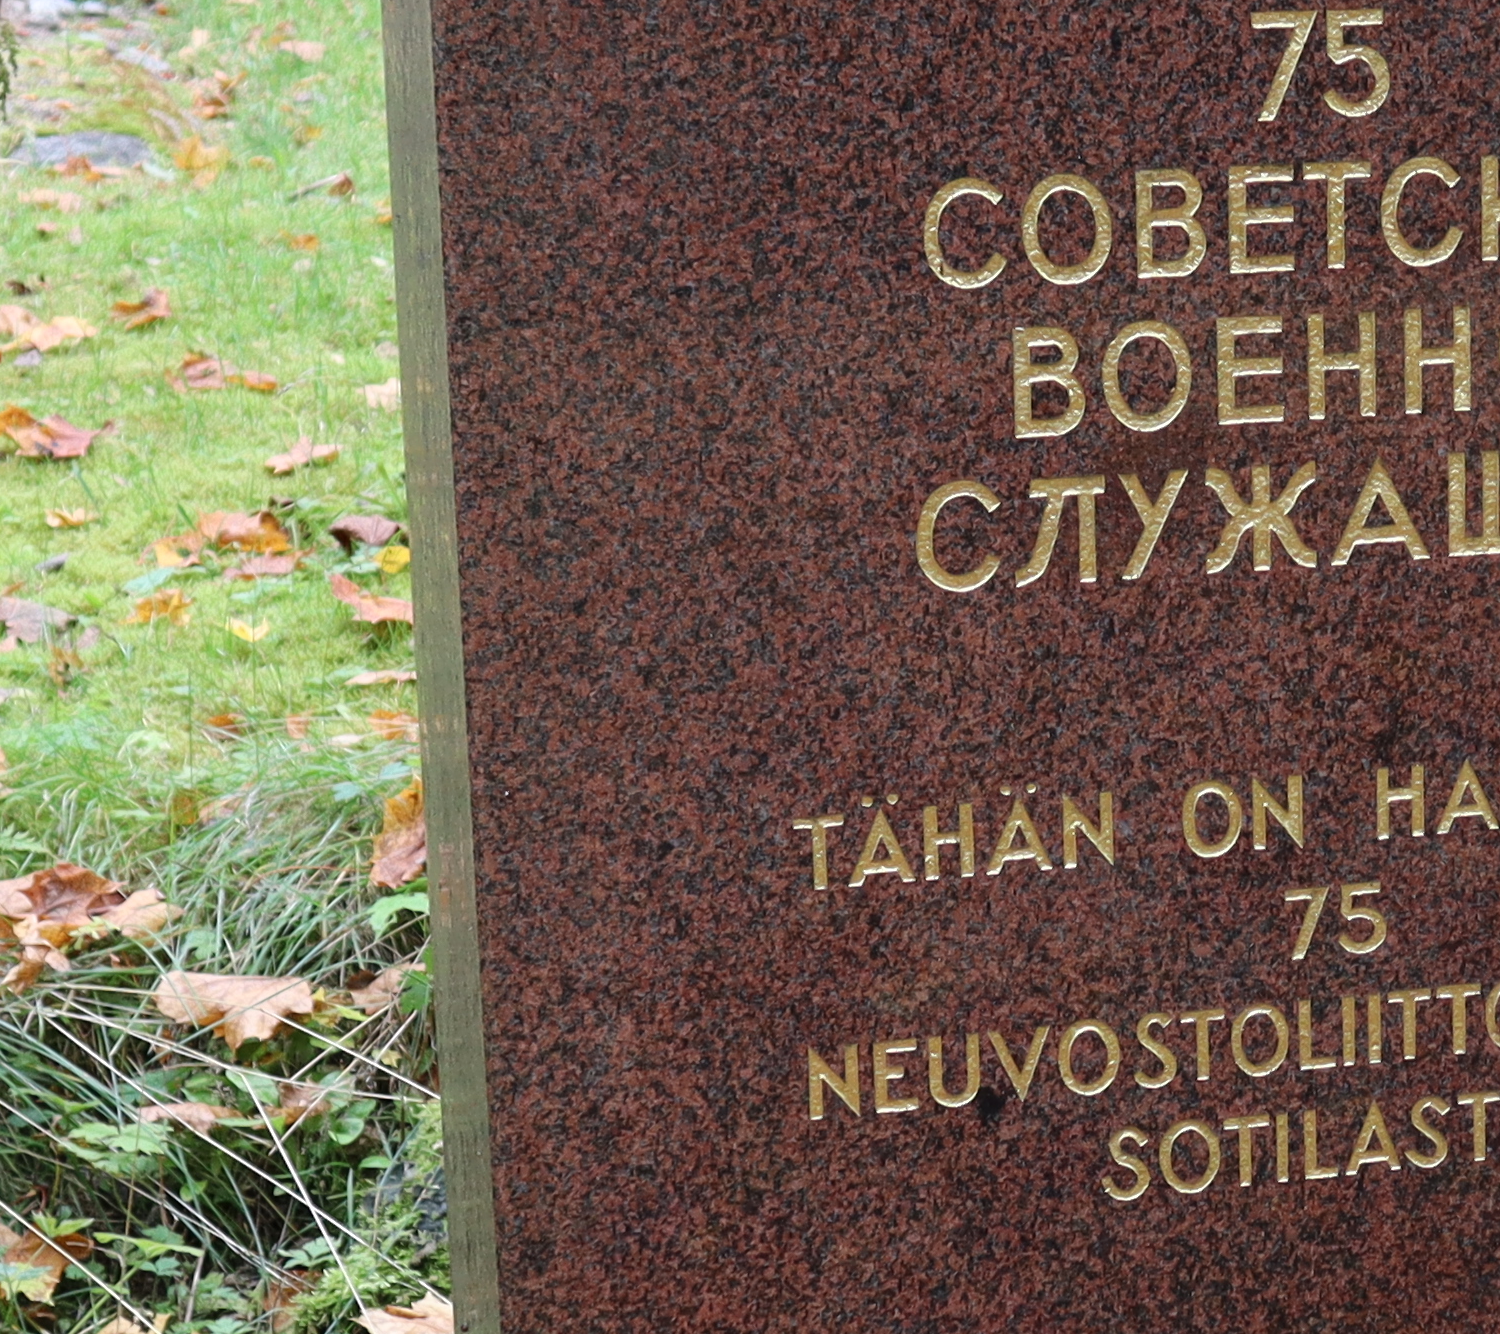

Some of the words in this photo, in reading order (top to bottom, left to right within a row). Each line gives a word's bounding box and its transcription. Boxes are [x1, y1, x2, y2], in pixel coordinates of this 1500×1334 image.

[1251, 9, 1391, 122] 75
[792, 783, 1114, 890] TÄHÄN
[1182, 775, 1304, 858] ON
[1284, 881, 1387, 960] 75
